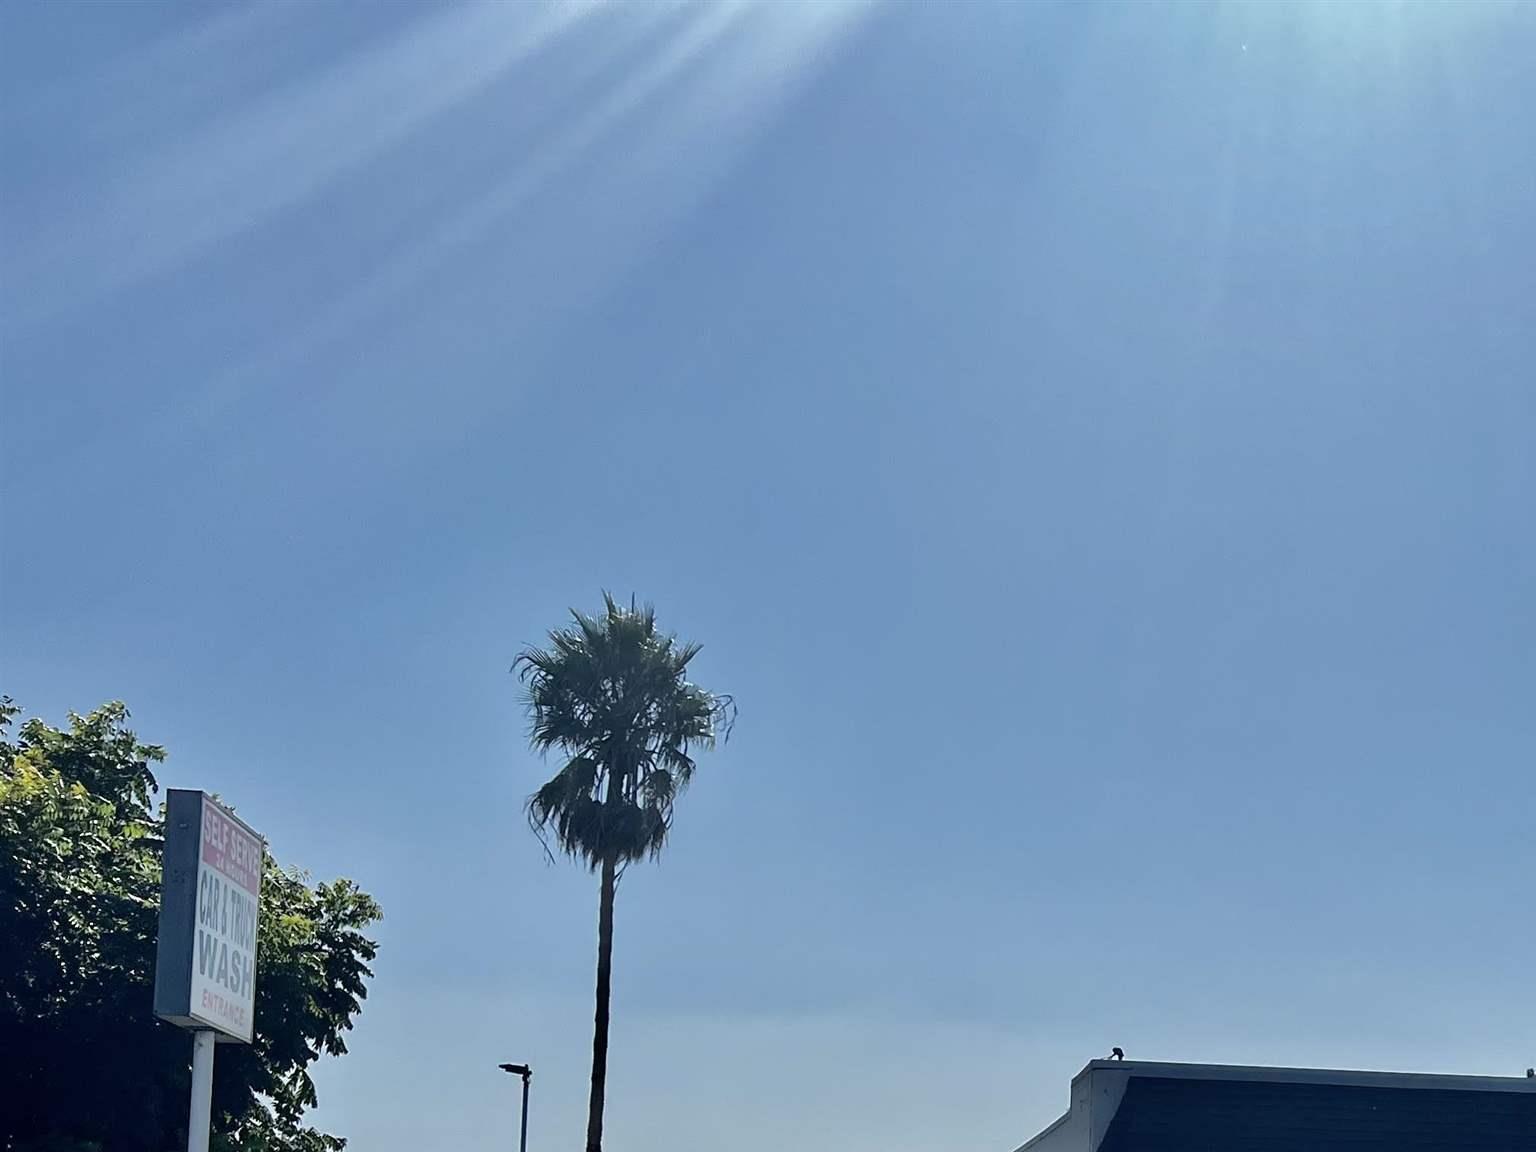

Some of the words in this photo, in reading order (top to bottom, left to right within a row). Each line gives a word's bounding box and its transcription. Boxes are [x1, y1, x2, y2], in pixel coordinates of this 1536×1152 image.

[205, 809, 228, 855] SELF
[231, 829, 259, 877] SERVE
[201, 870, 220, 932] CAR
[200, 929, 254, 1001] WASH
[202, 988, 245, 1025] ENTRANCE
